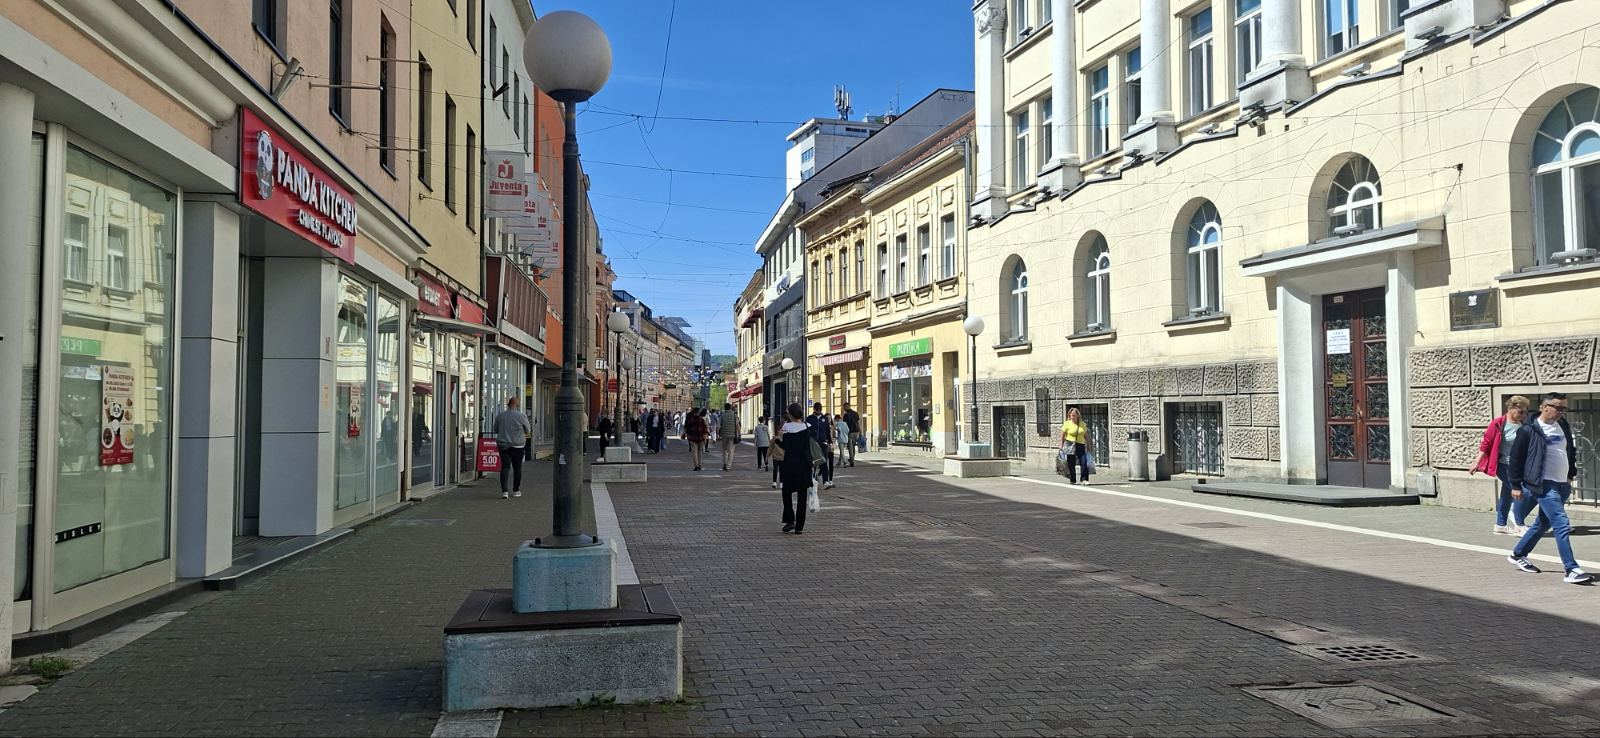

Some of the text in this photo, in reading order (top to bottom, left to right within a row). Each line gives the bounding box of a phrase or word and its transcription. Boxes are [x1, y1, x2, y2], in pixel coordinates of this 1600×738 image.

[277, 147, 357, 234] PANDA KITCHEN
[489, 180, 522, 190] Juventa
[298, 208, 321, 236] CHINESE
[482, 455, 498, 465] 5.00
[55, 524, 101, 542] SISLEY
